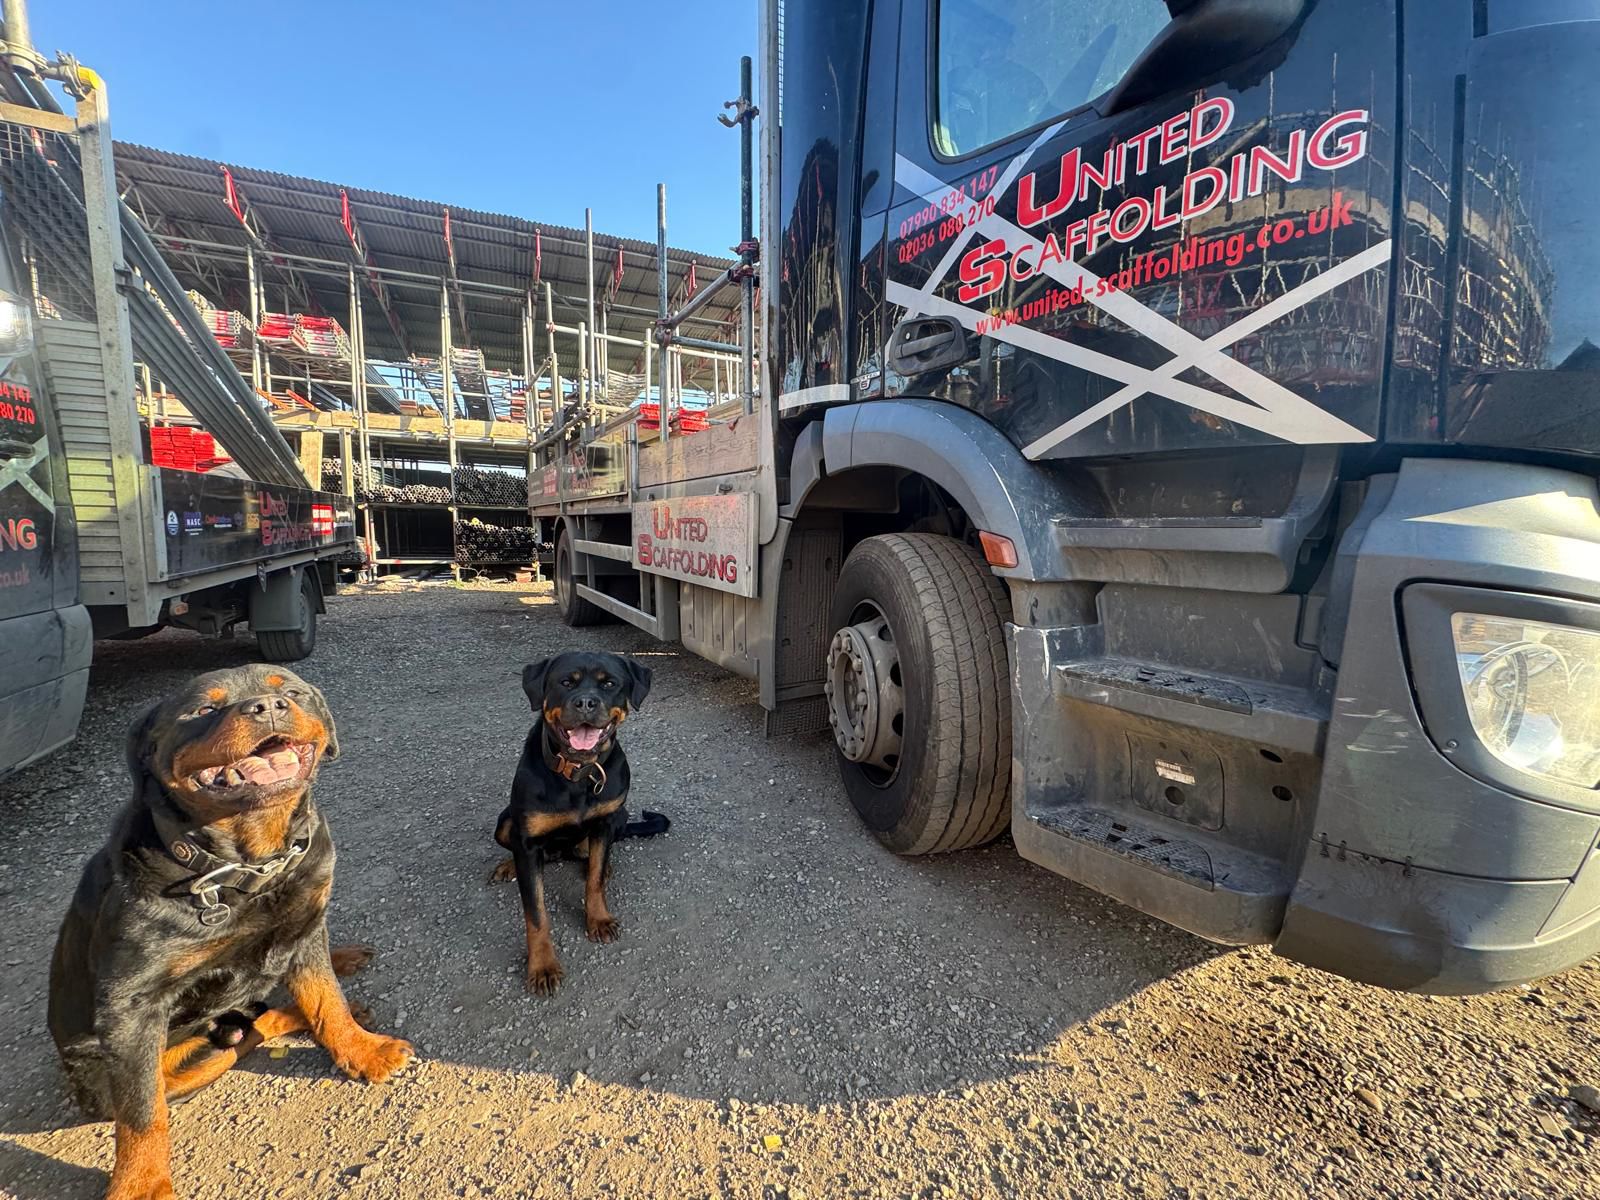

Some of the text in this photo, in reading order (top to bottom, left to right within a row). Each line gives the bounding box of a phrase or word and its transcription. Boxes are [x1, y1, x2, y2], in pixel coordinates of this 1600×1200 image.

[1017, 96, 1235, 229] UNITED
[898, 195, 995, 264] 02036 080 270
[900, 165, 998, 239] 07990 834 147
[957, 109, 1369, 304] SCAFFOLDING
[975, 192, 1354, 336] www.united-scaffolding.co.uk
[11, 384, 31, 403] 147
[15, 405, 36, 425] 270
[186, 518, 201, 526] NASC
[653, 506, 708, 542] UNITED
[638, 533, 738, 584] SCAFFOLDING
